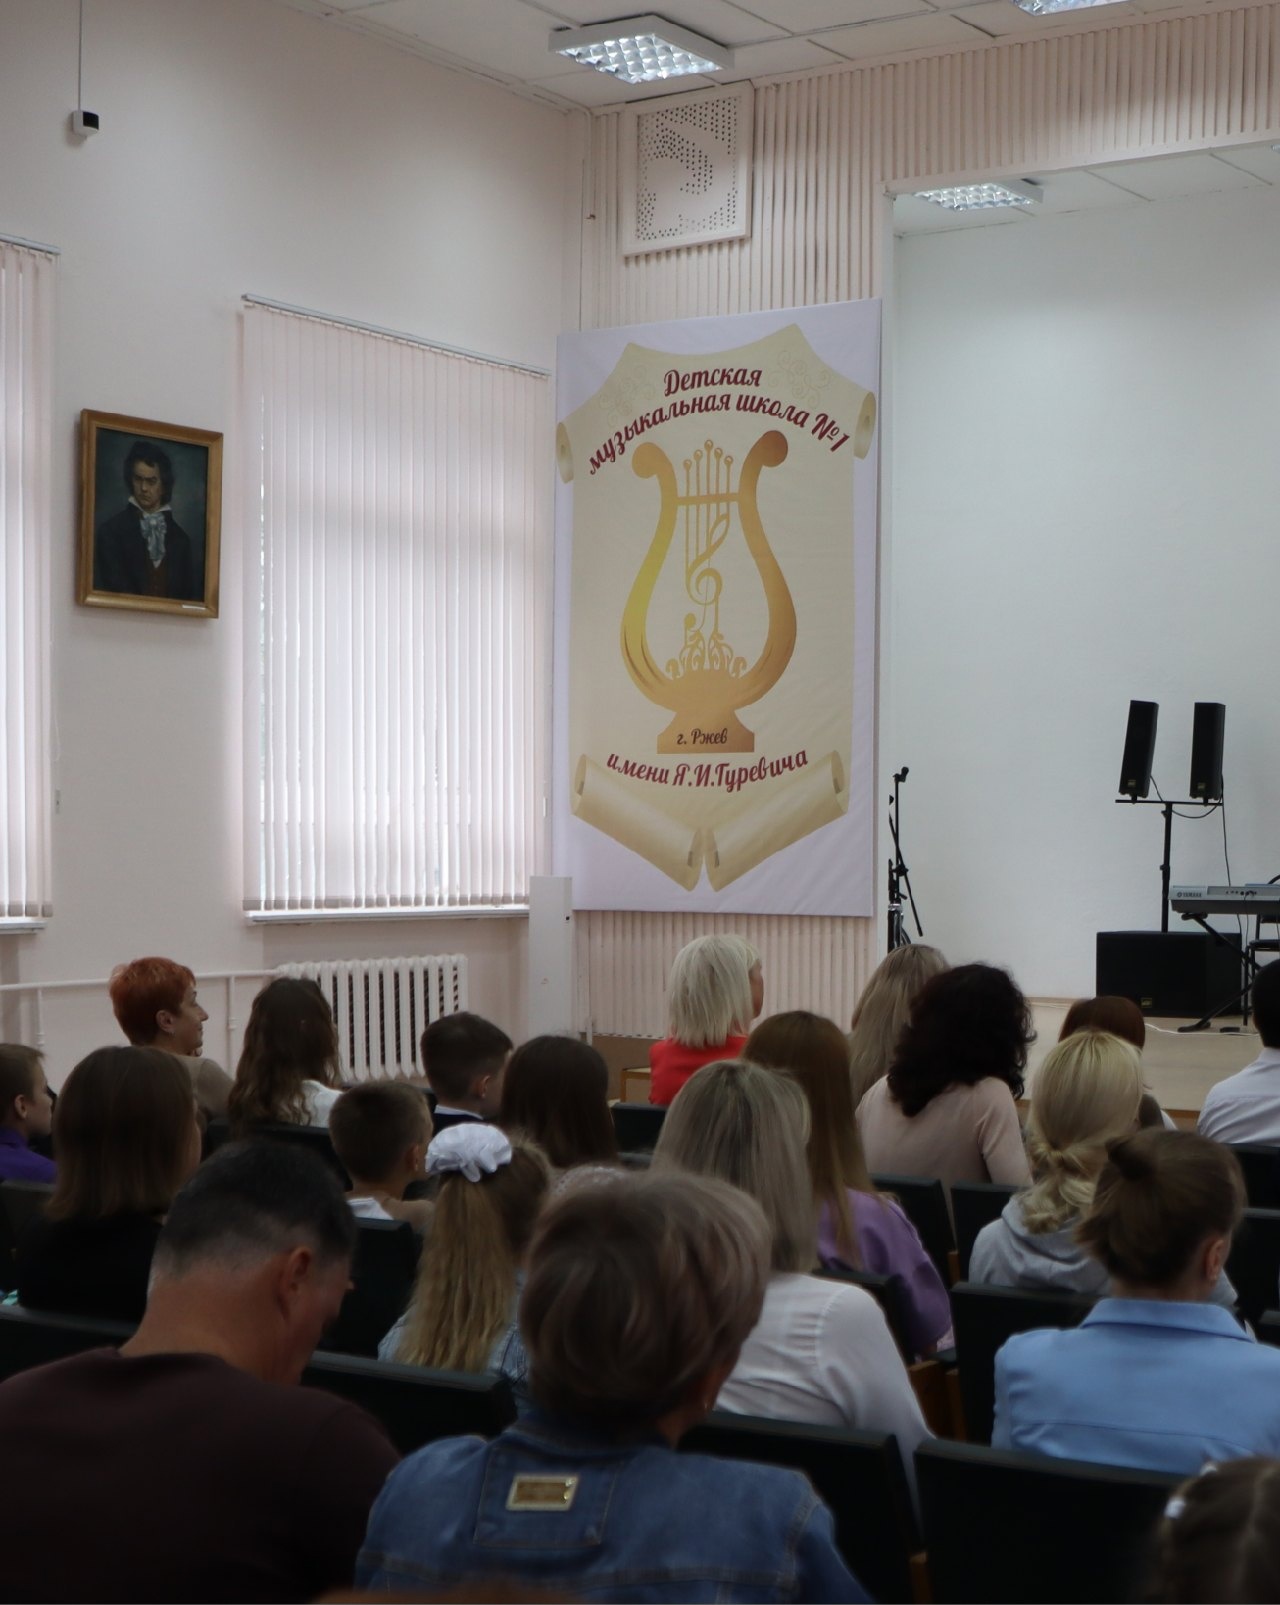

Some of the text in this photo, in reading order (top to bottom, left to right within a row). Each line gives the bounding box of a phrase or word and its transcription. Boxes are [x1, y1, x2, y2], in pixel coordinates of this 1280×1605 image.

[664, 368, 762, 396] Детская
[589, 394, 849, 474] музыкальная школа №1
[677, 728, 728, 745] г. Ржев
[606, 753, 669, 785] имени
